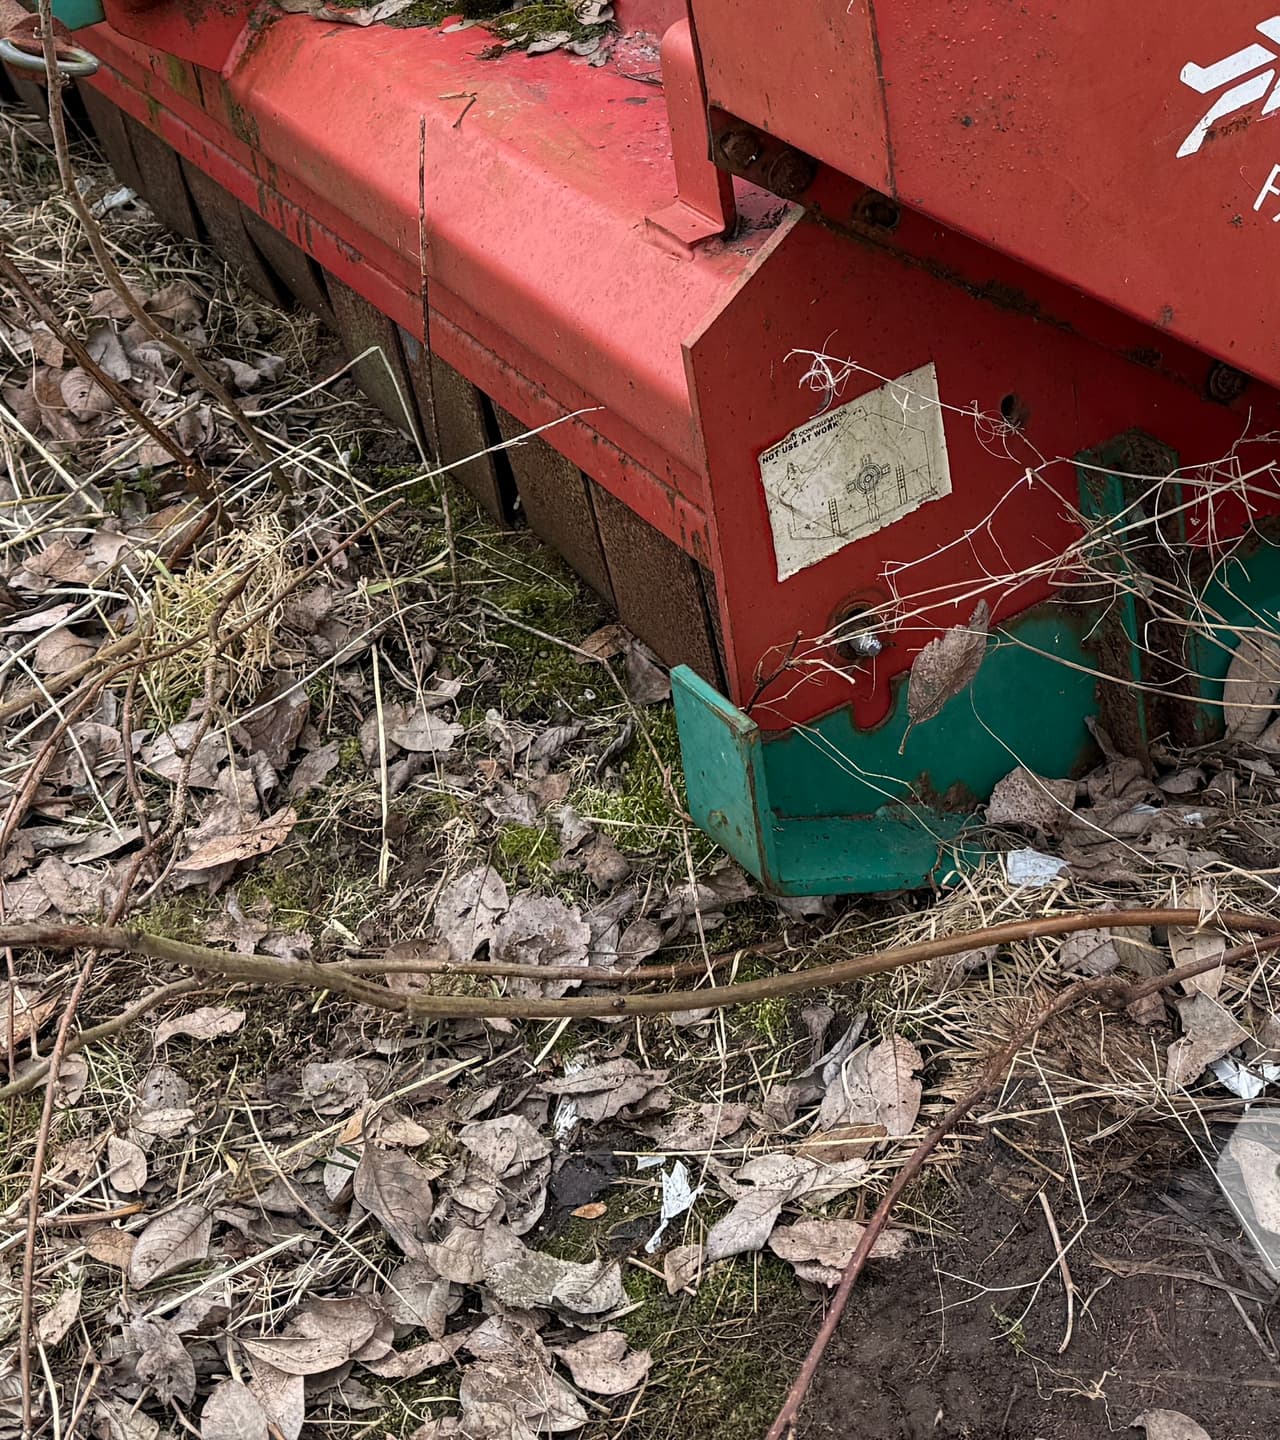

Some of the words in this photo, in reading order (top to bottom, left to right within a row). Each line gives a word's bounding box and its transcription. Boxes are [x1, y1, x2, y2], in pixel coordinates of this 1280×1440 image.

[762, 449, 781, 465] NOT
[781, 440, 800, 455] USE
[801, 434, 812, 445] AT
[813, 420, 841, 438] WORK
